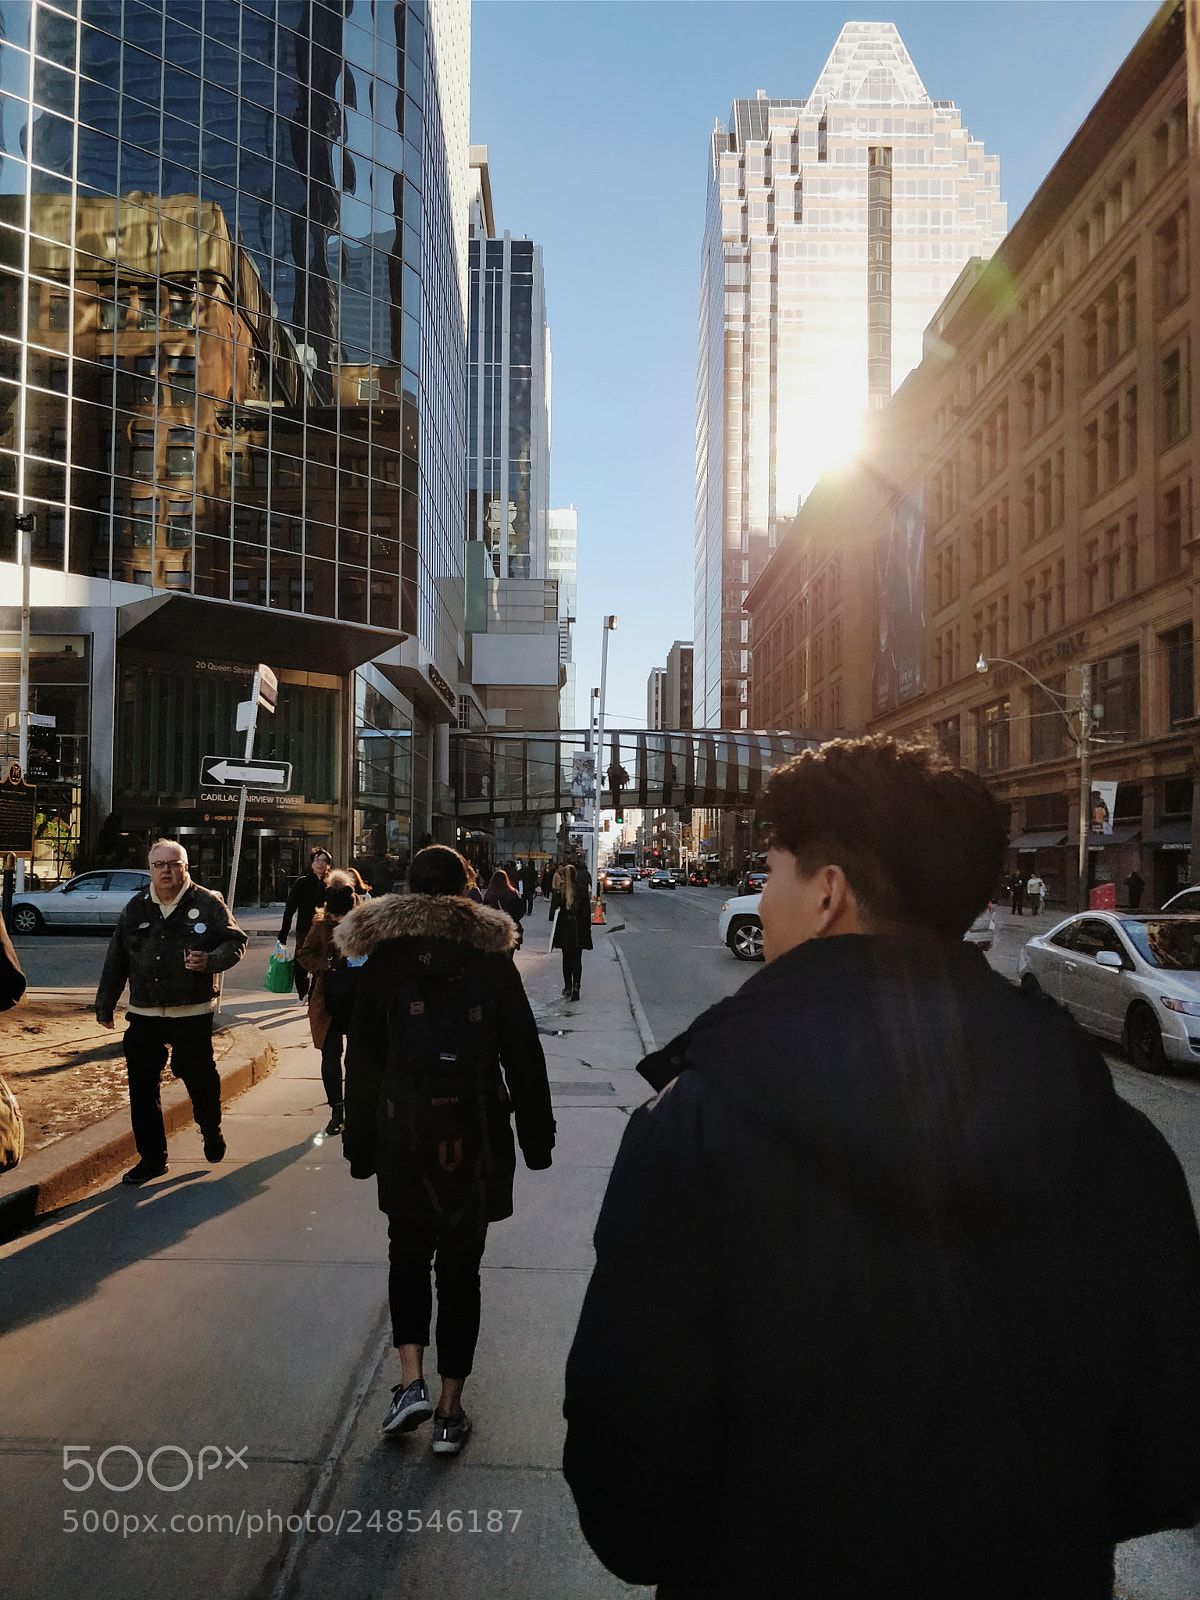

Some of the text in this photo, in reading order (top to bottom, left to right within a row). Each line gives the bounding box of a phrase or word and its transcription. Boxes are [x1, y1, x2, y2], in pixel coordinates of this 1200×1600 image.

[195, 661, 254, 675] 20 Queen Street
[200, 793, 302, 805] CADILLAC AIRVIEW TOWER
